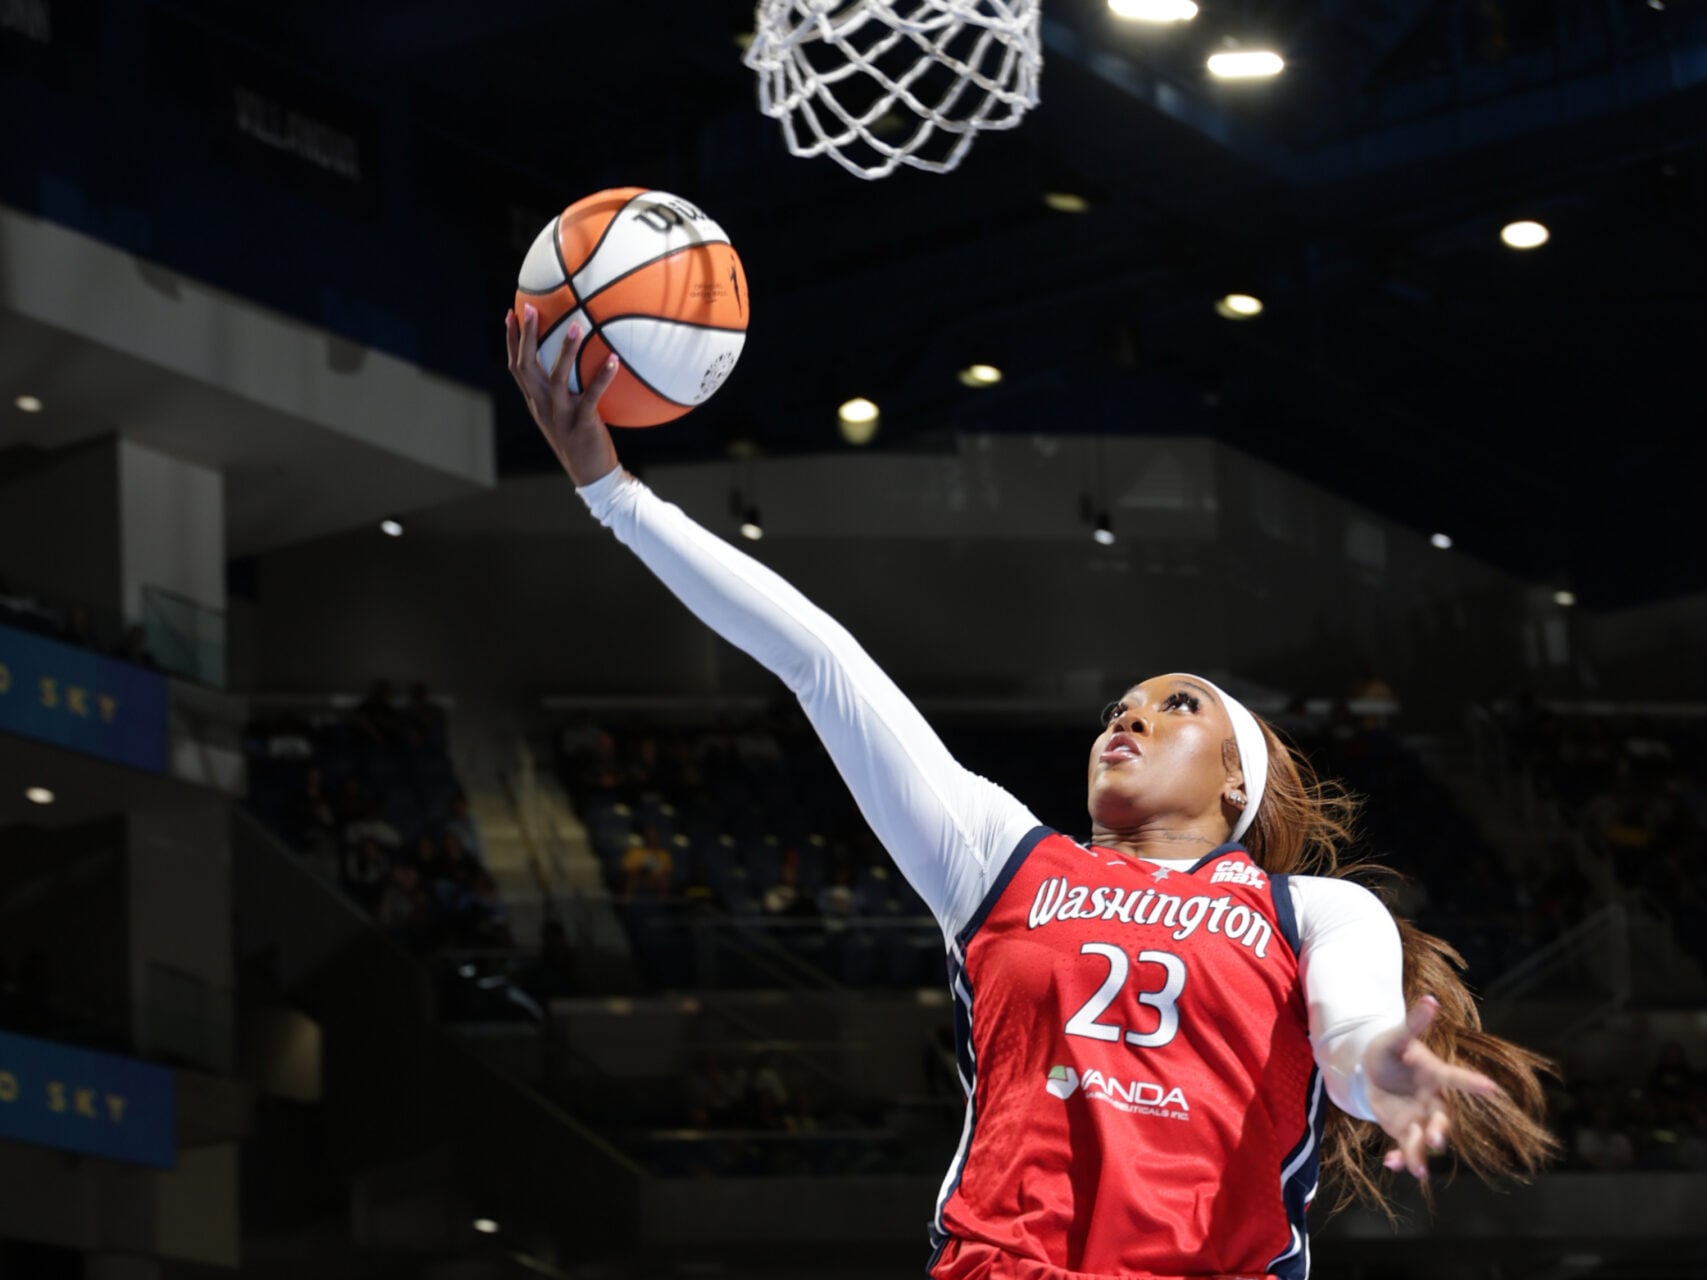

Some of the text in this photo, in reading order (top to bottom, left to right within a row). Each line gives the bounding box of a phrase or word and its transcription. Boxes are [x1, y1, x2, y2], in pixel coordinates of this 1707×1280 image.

[37, 675, 120, 724] SKY
[1028, 876, 1273, 958] Washington
[1064, 942, 1188, 1048] 23
[46, 1080, 129, 1124] SKY
